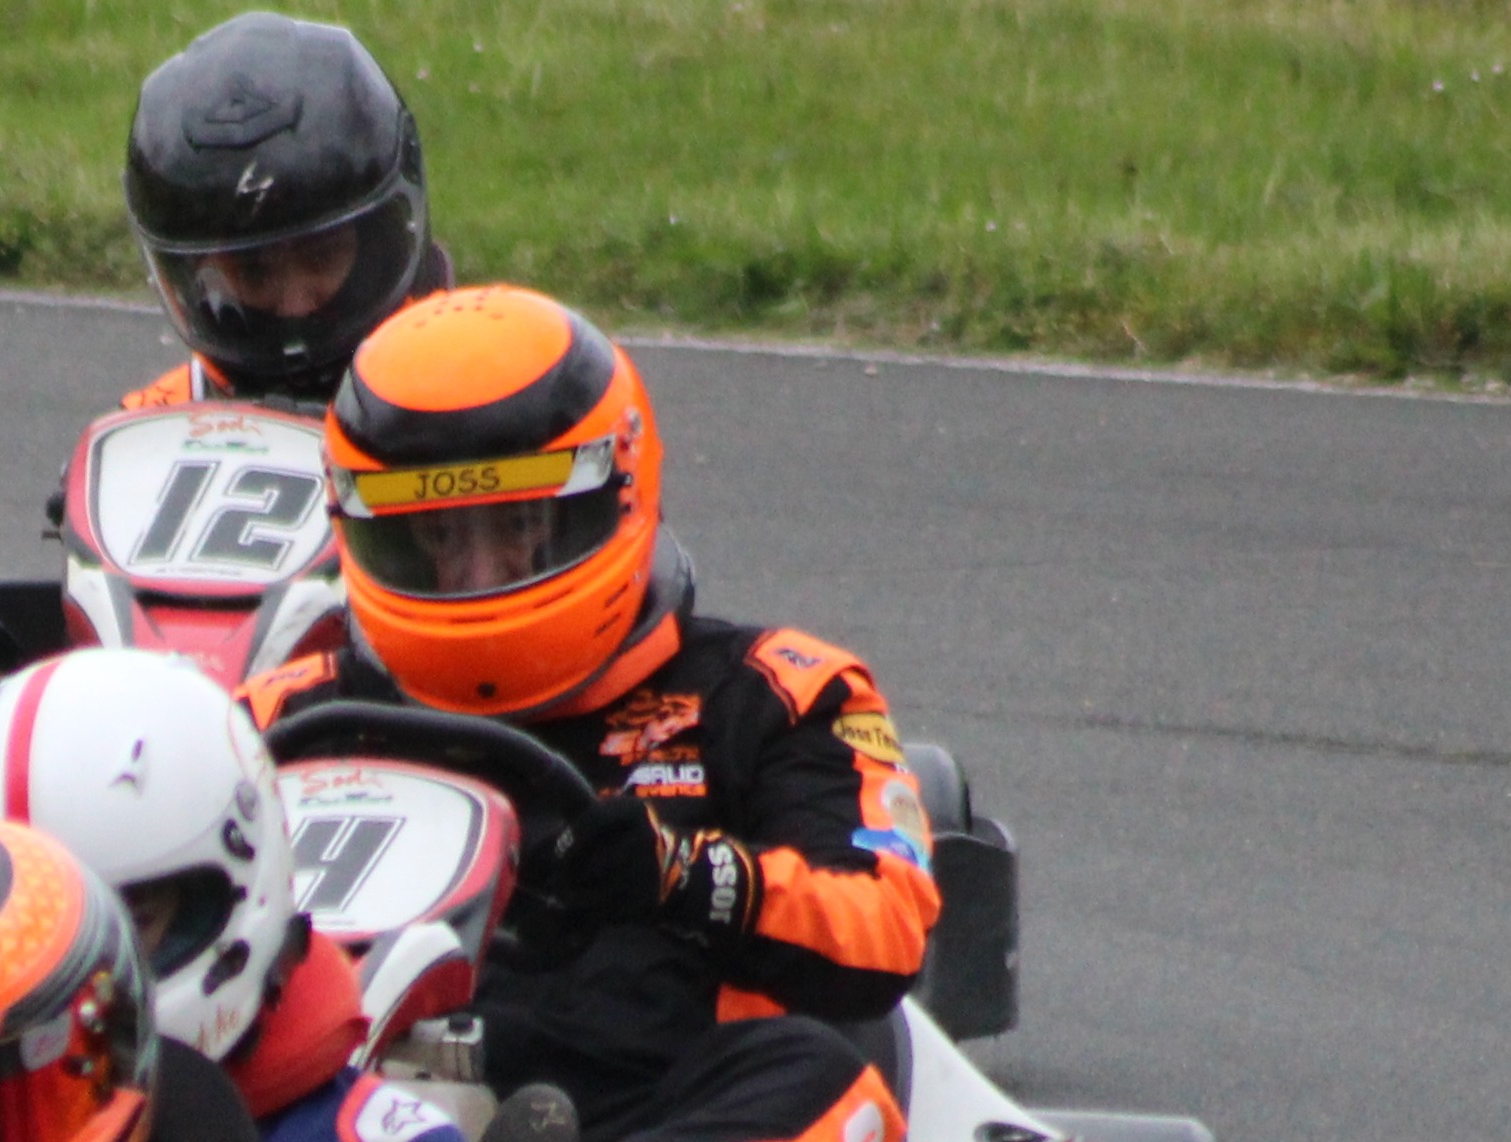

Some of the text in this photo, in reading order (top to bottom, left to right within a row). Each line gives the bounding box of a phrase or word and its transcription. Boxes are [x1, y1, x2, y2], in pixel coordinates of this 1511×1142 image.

[127, 460, 324, 571] 12
[413, 466, 501, 499] JOSS
[707, 842, 738, 925] JOSS
